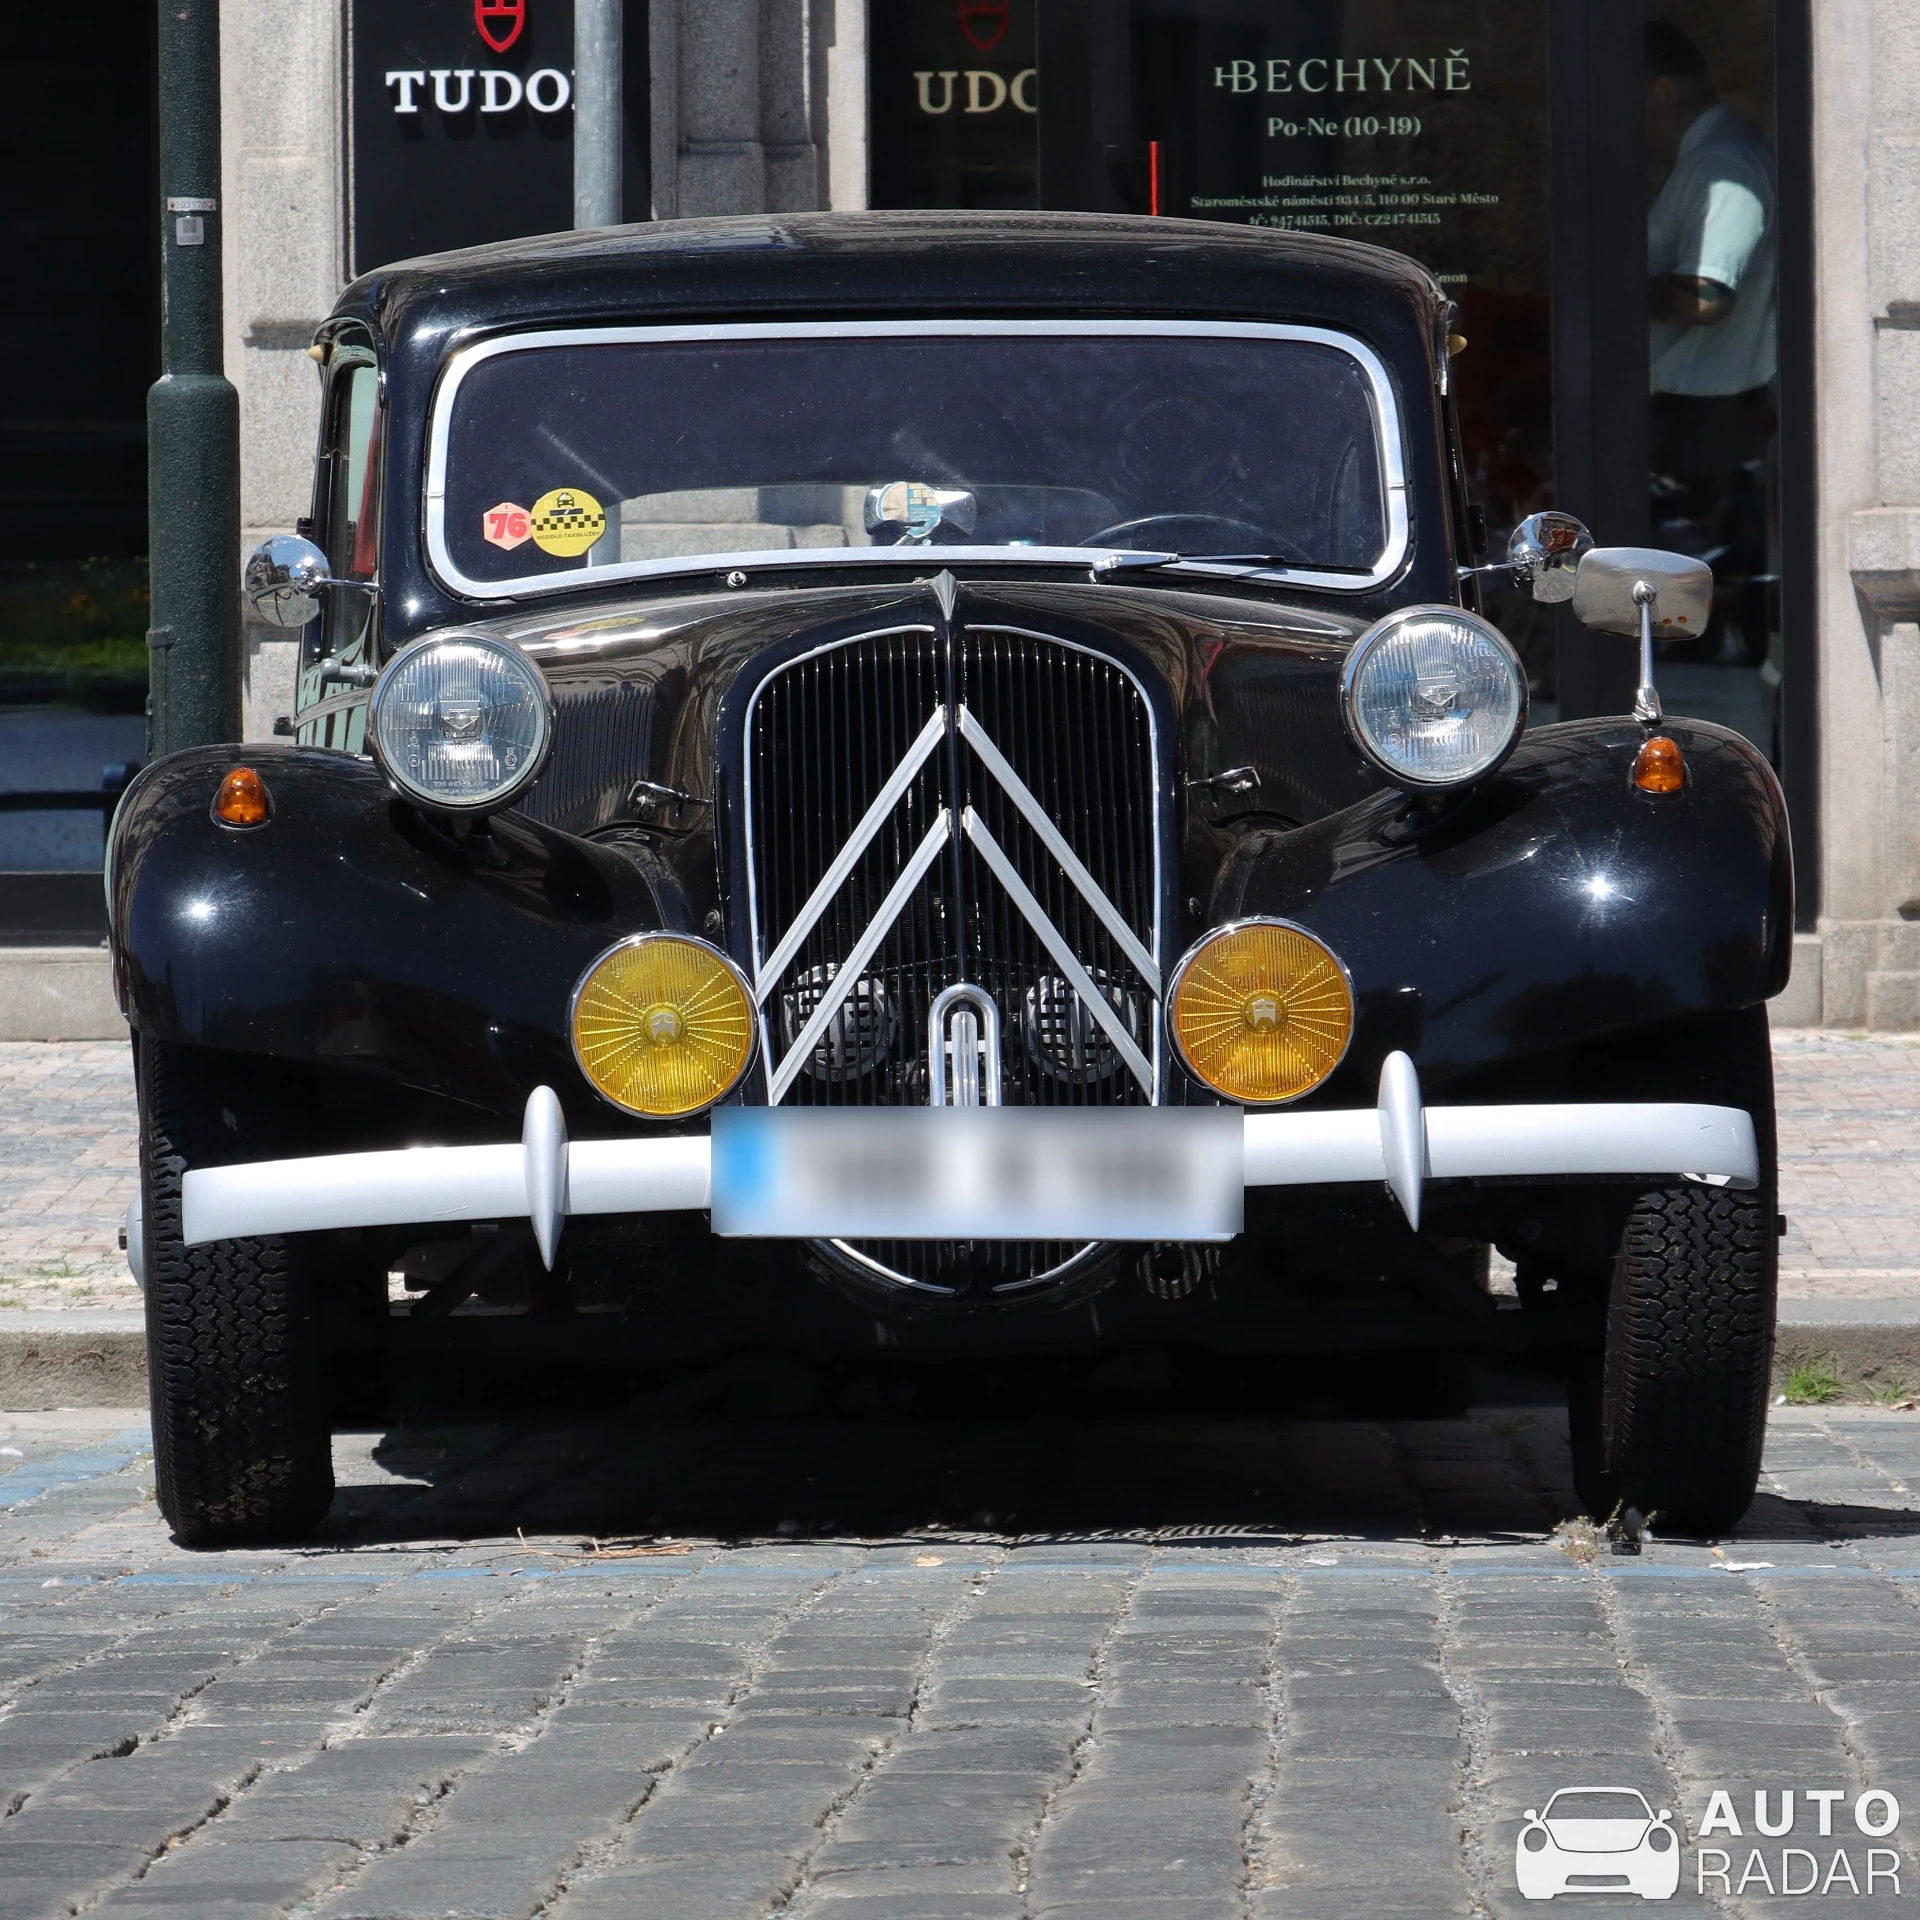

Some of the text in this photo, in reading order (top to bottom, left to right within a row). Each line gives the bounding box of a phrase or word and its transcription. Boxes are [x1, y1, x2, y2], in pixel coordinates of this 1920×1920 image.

[385, 68, 575, 113] TUDO
[1267, 116, 1421, 138] Po-Ne (10-19)
[1400, 175, 1431, 185] s.r.o.
[1422, 192, 1457, 205] Staré
[1461, 191, 1499, 204] Město
[489, 512, 527, 539] 76
